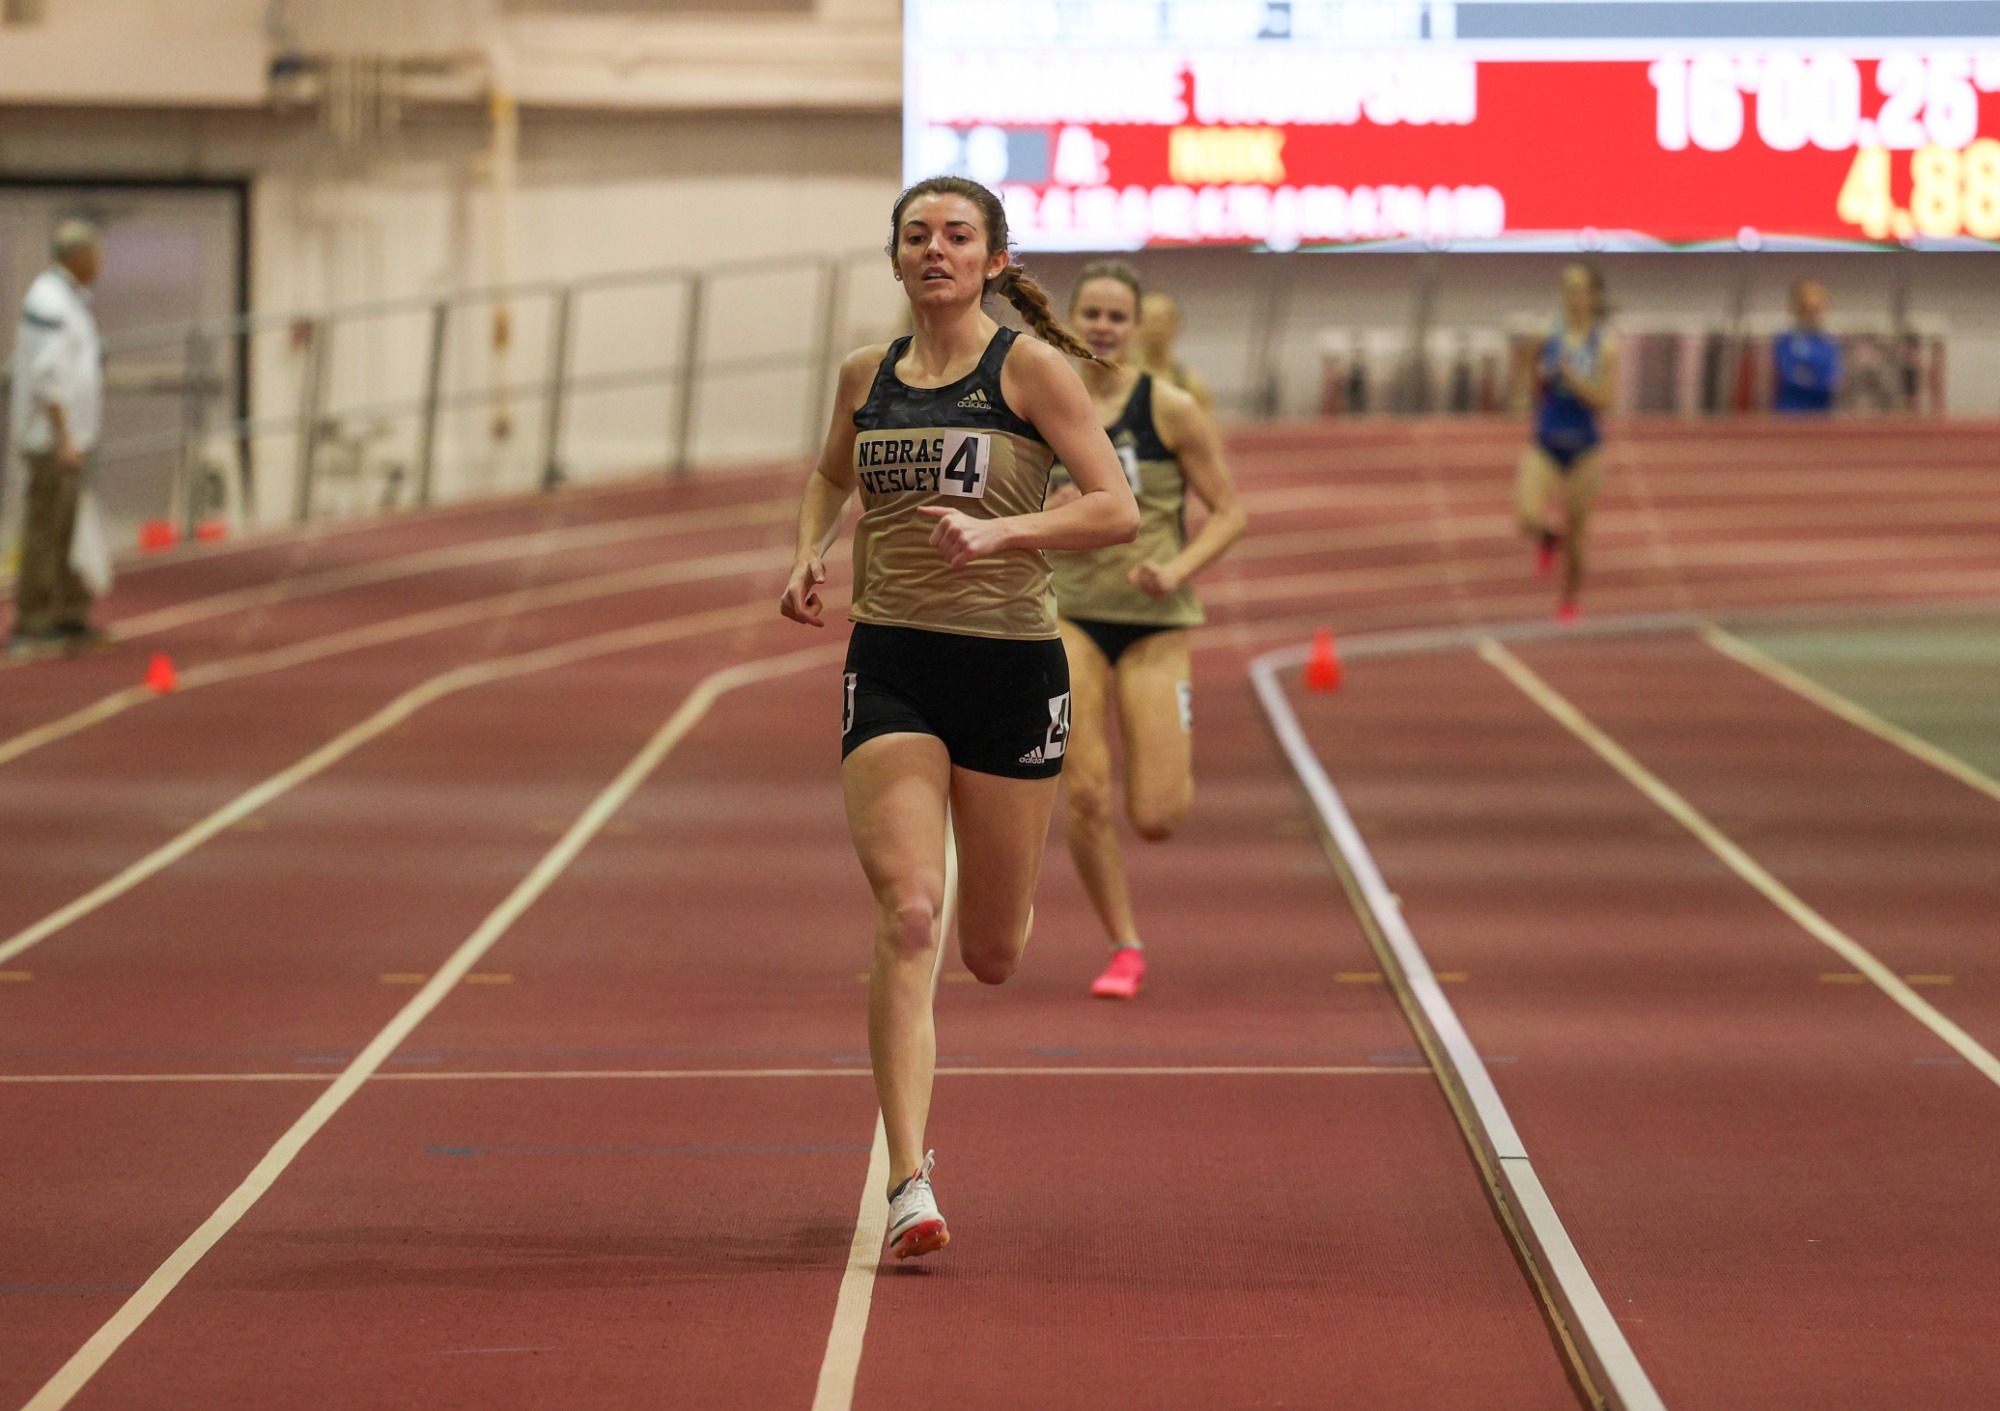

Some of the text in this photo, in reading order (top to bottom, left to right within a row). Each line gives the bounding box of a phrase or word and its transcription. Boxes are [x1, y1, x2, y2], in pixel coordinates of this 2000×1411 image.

[957, 400, 992, 410] adidas
[859, 438, 944, 467] NEBRAS
[945, 436, 980, 493] 4
